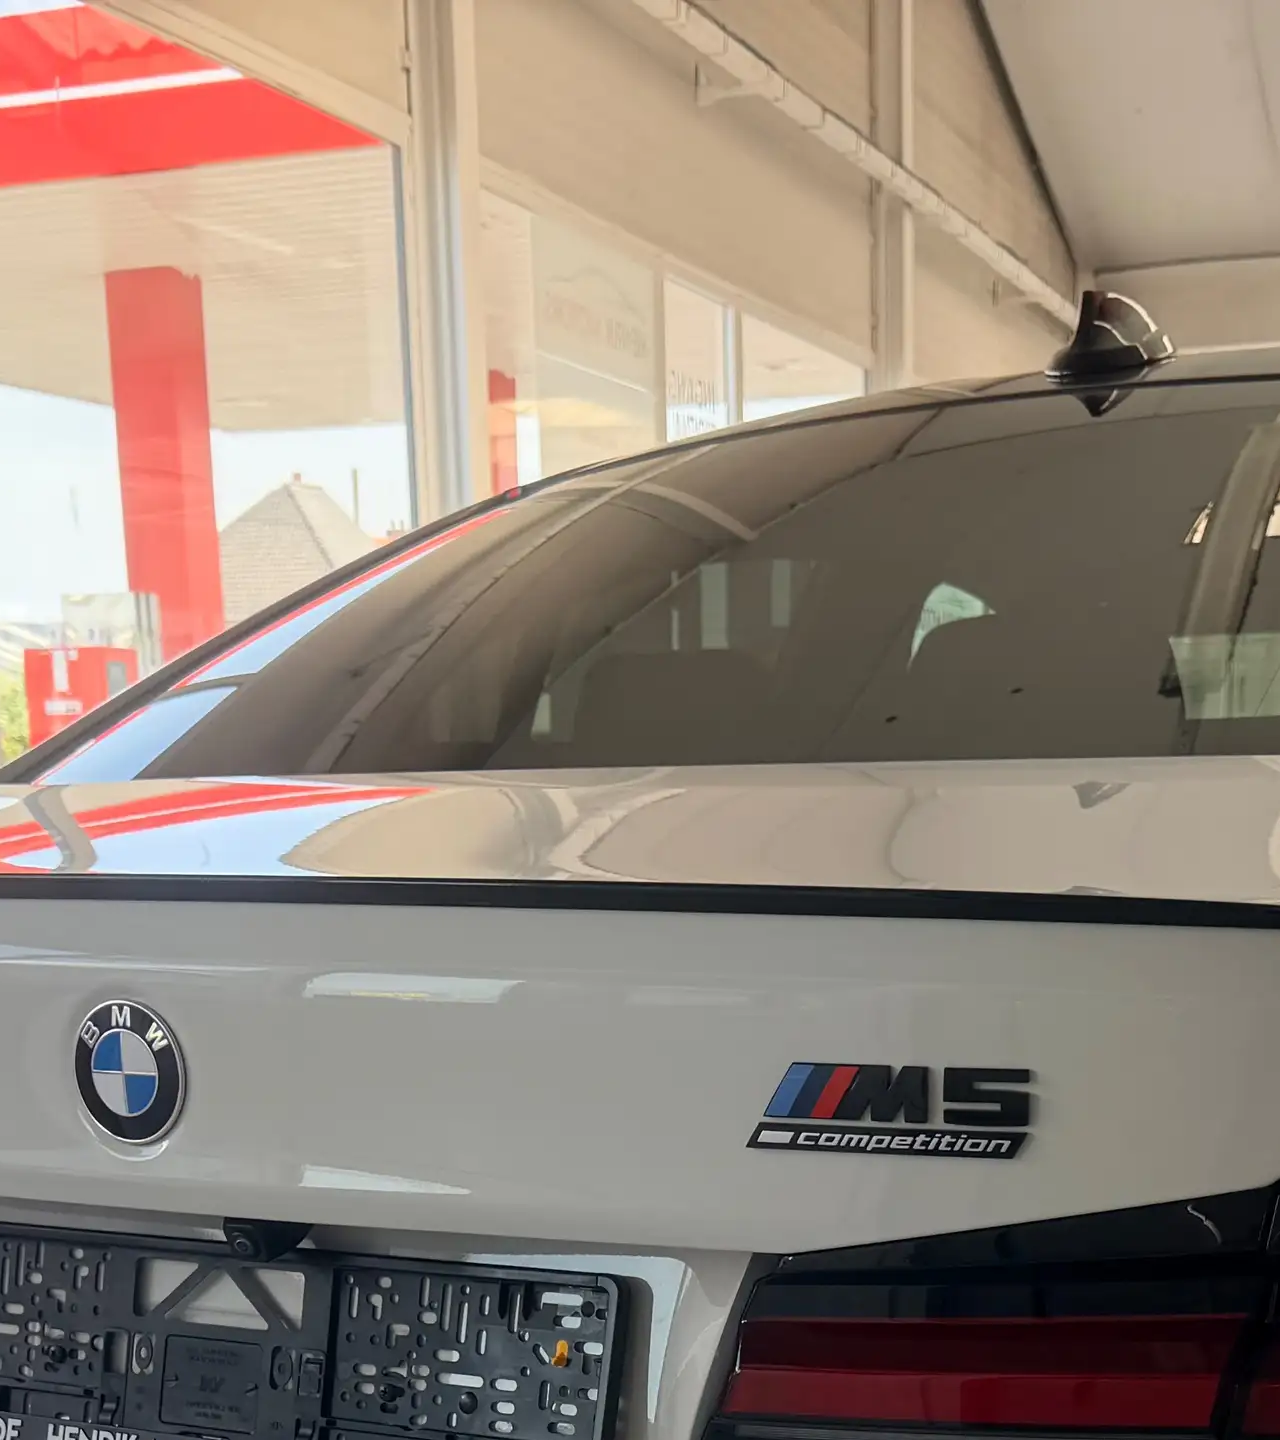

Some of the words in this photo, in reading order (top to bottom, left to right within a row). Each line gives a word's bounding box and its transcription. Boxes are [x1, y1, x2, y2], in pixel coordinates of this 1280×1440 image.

[81, 1005, 169, 1052] BMW
[832, 1064, 1031, 1126] M5
[796, 1131, 1012, 1154] competition
